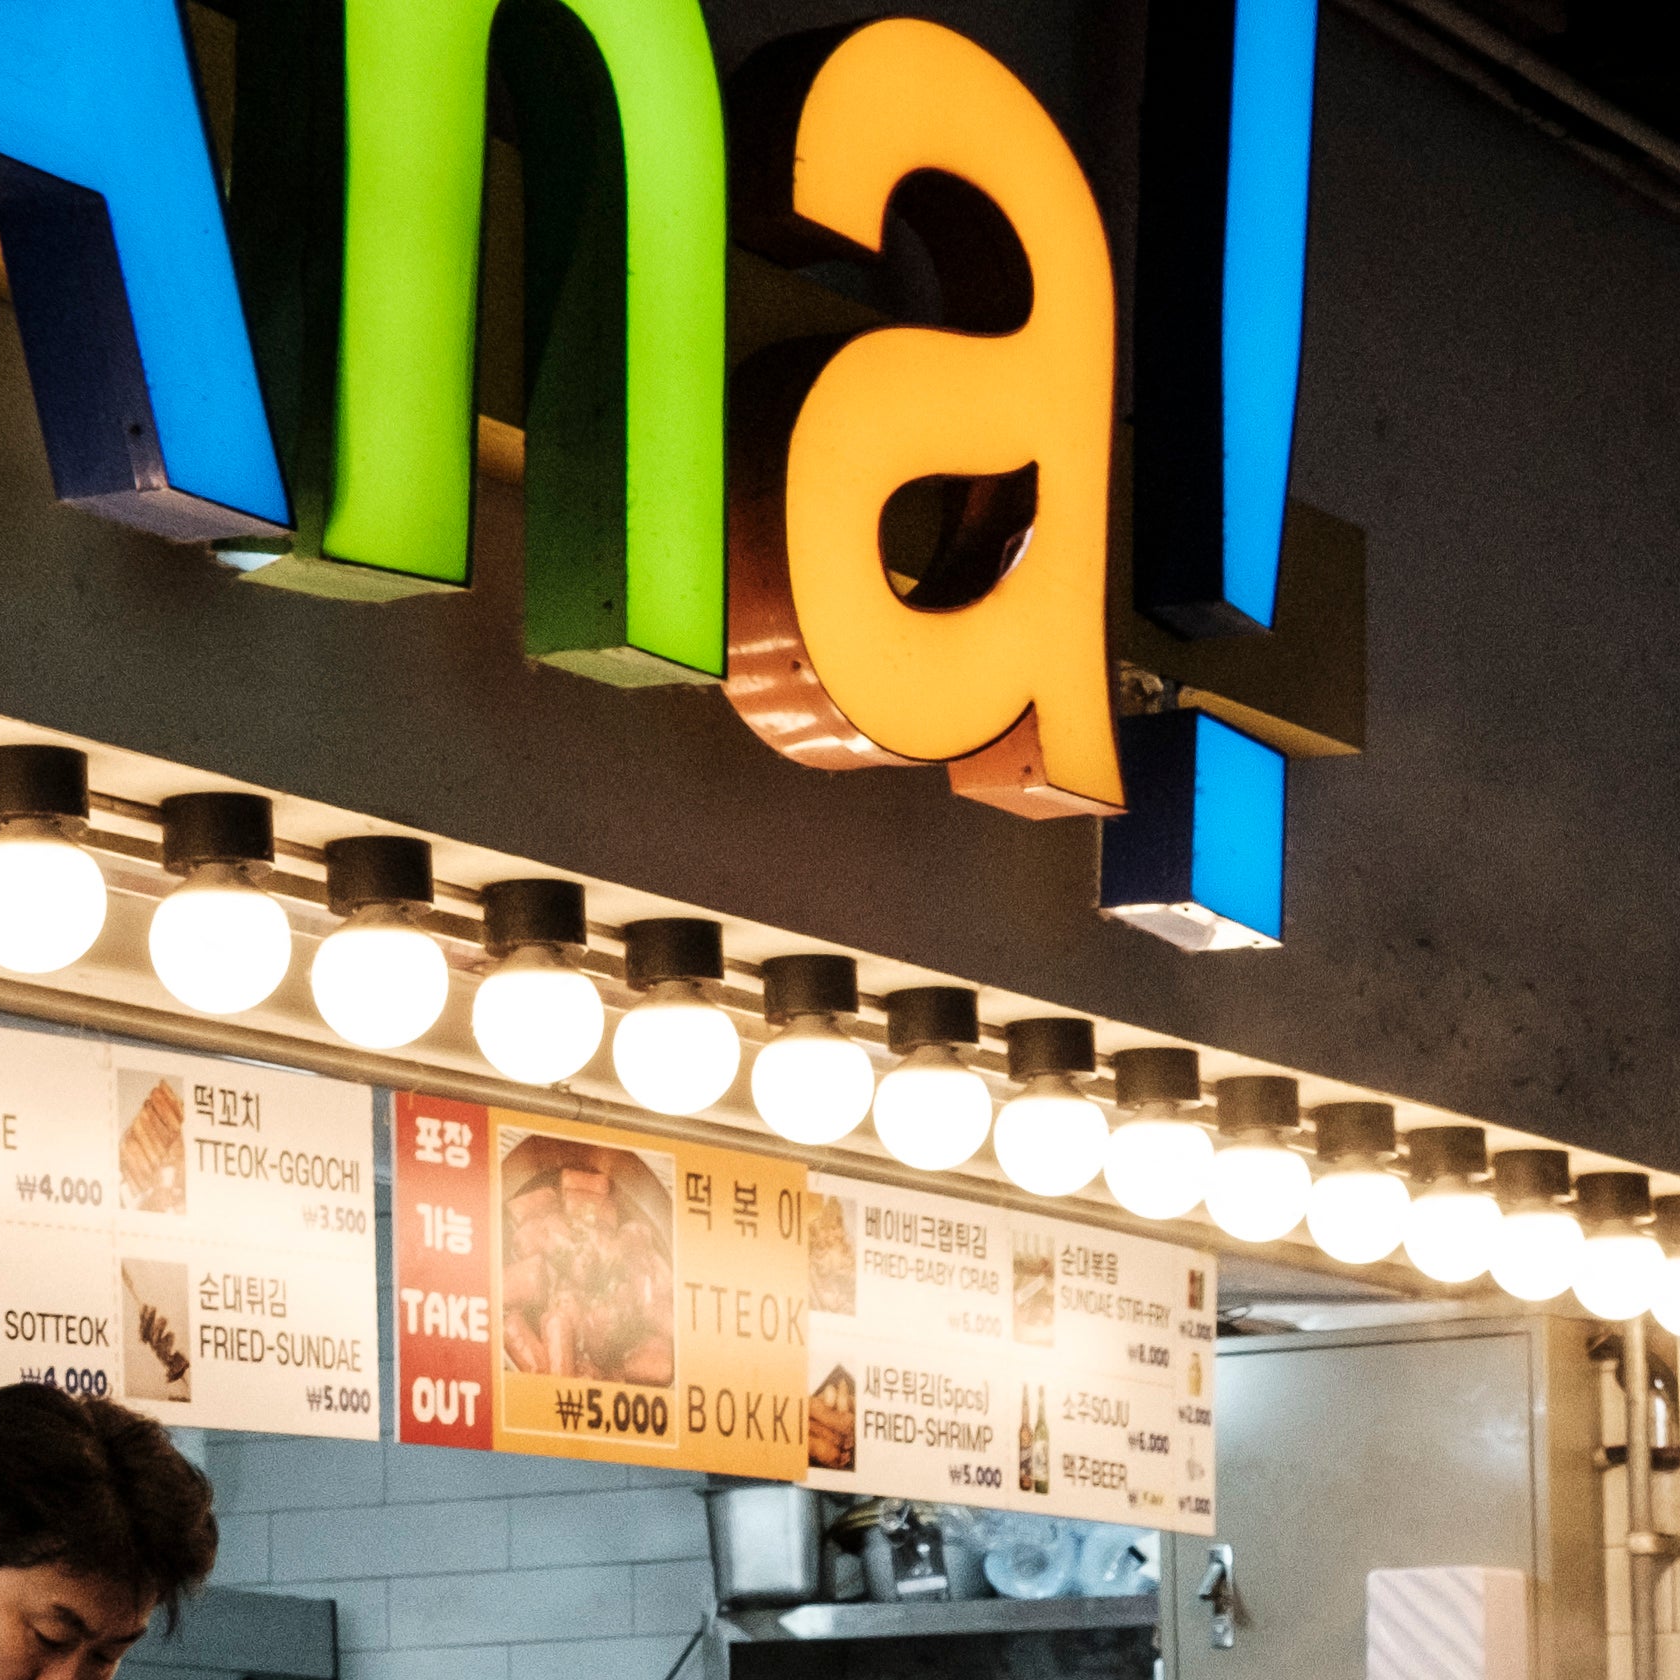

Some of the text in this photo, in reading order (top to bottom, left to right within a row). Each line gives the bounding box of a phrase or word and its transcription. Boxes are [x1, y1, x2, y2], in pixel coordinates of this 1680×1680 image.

[194, 1083, 262, 1134] 떡꼬치
[194, 1137, 363, 1195] TTEOK-GGOCHI
[414, 1114, 473, 1169] 포장
[419, 1203, 474, 1256] 가능
[863, 1249, 958, 1285] FRIED-BABY
[198, 1270, 289, 1319] 순대튀김
[400, 1288, 490, 1344] TAKE
[684, 1280, 806, 1347] TTEOK
[4, 1309, 110, 1349] SOTTEOK
[198, 1325, 363, 1375] FRIED-SUNDAE
[411, 1375, 482, 1426] OUT
[555, 1385, 669, 1437] ₩5,000
[685, 1383, 806, 1447] BOKKI
[863, 1409, 995, 1454] FRIED-SHRIMP
